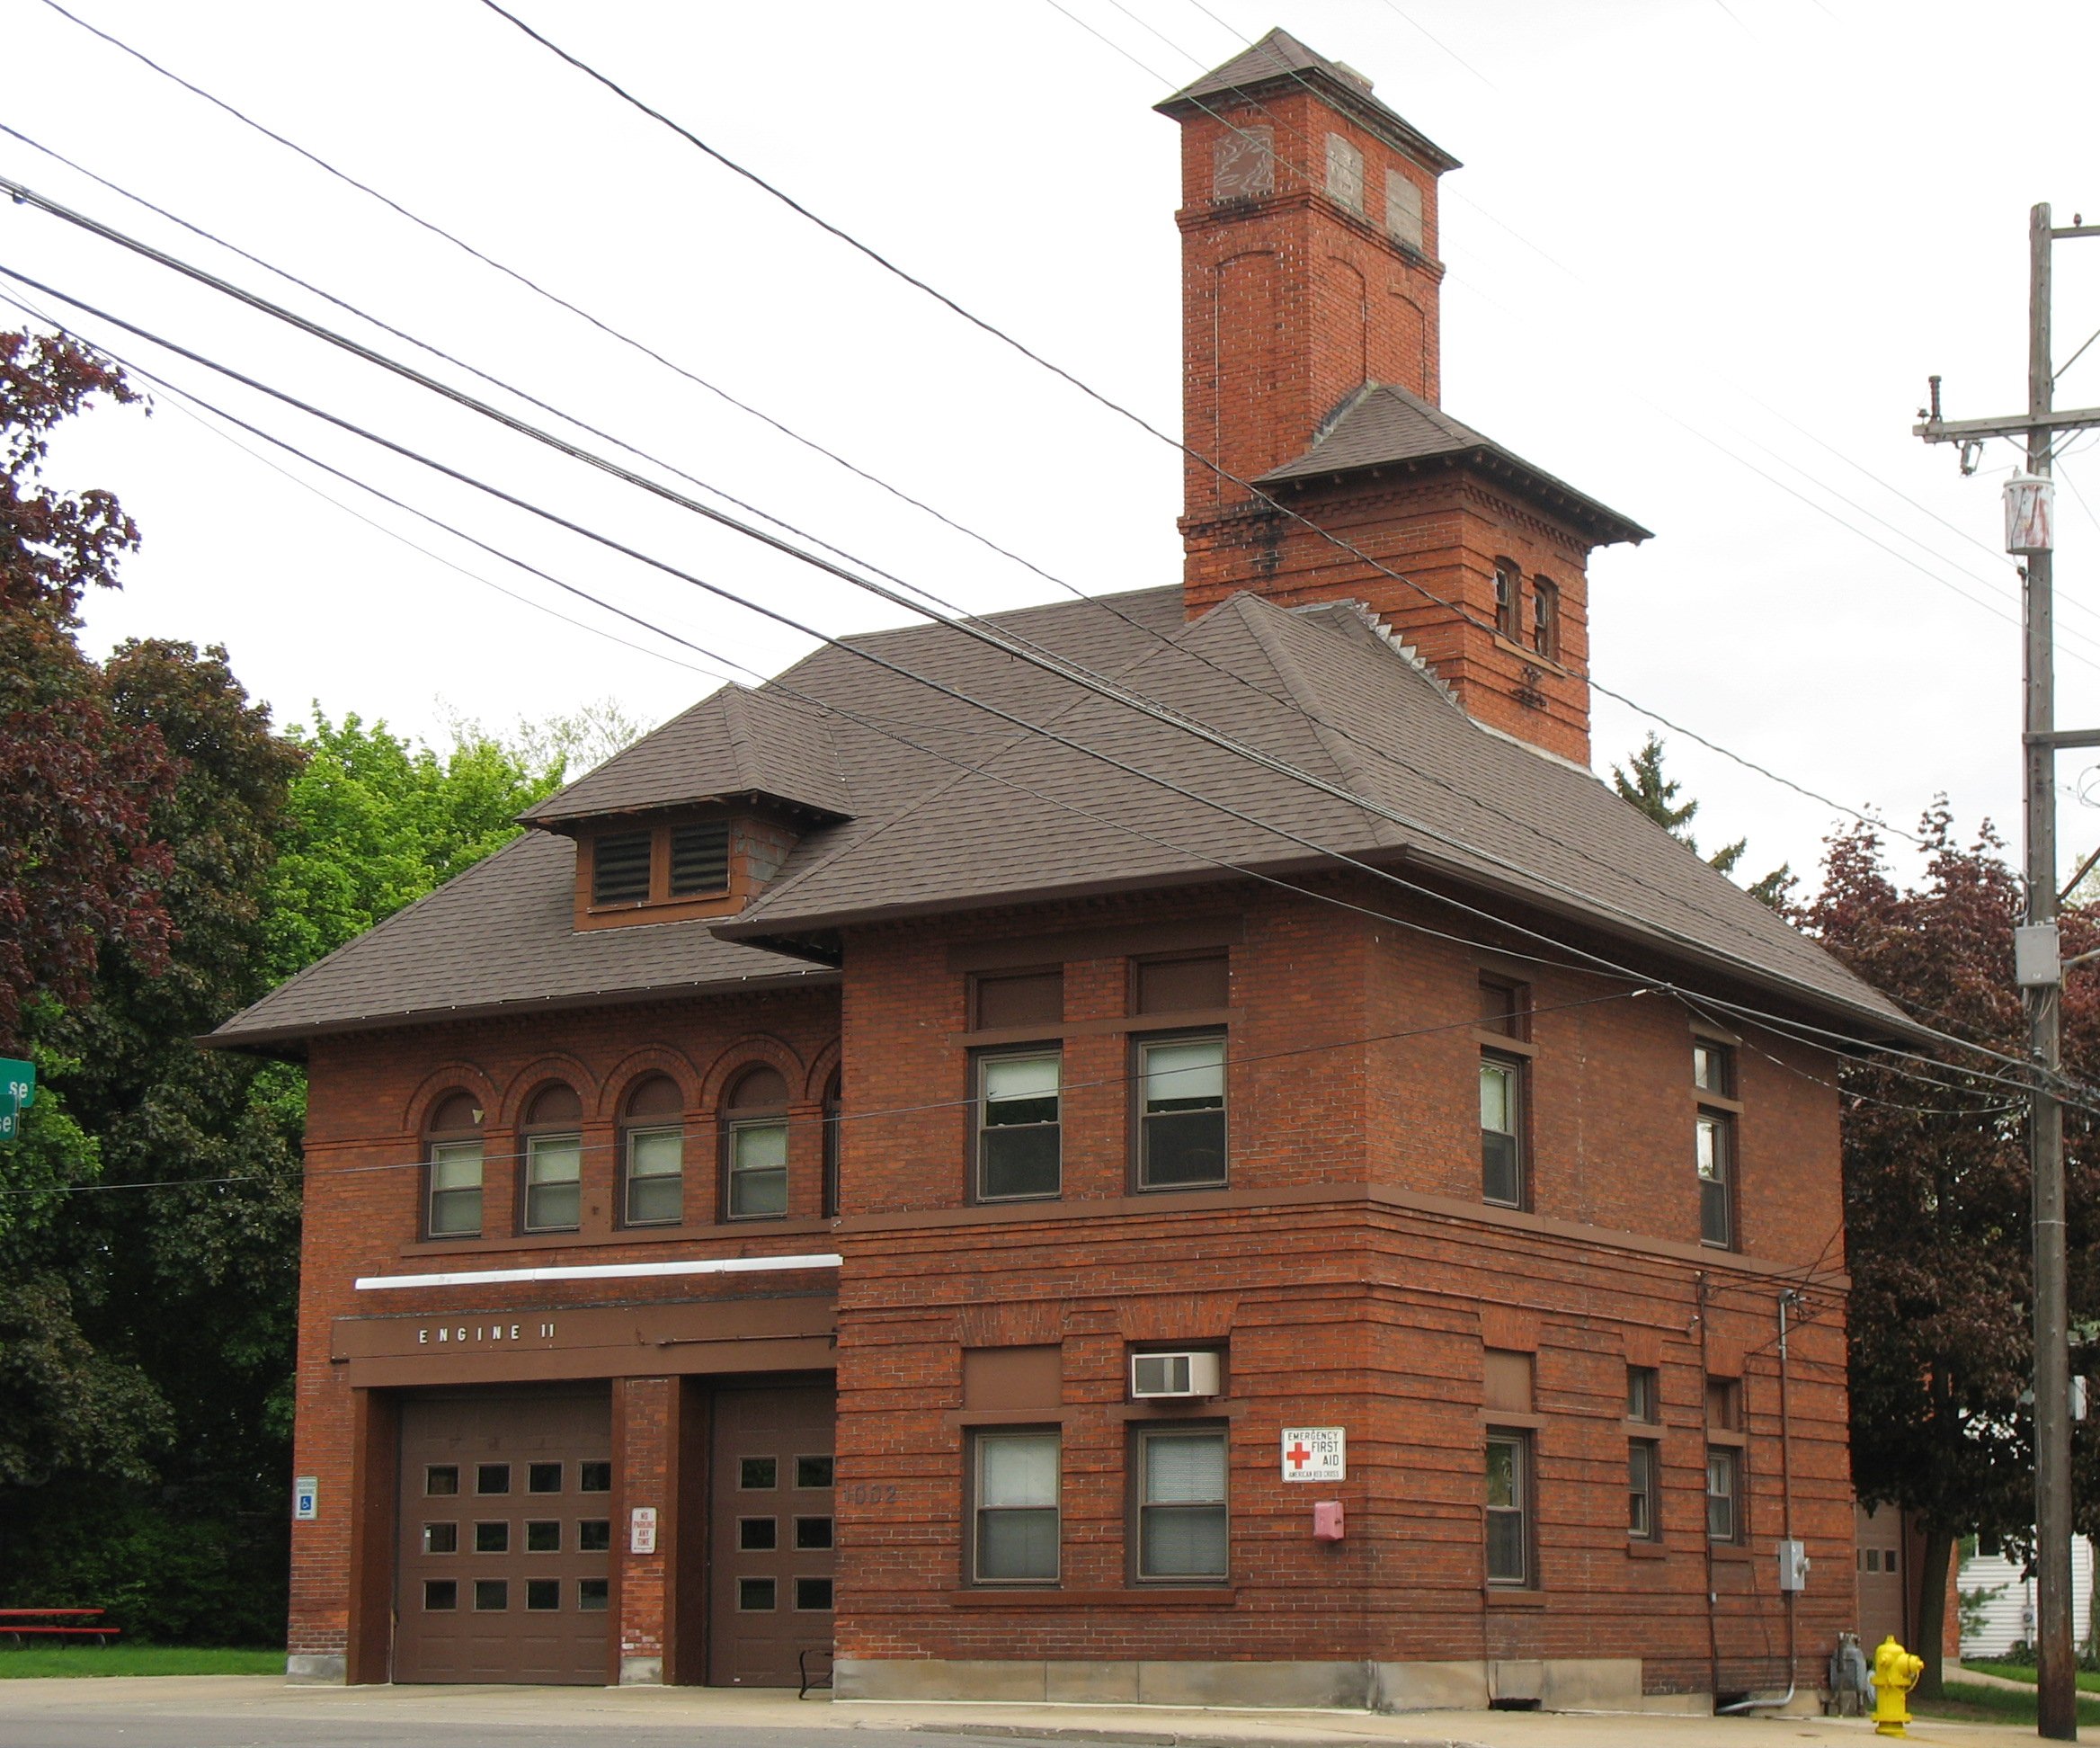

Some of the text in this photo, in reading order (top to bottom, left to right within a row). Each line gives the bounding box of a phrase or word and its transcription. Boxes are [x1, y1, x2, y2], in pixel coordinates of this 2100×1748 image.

[9, 1081, 28, 1098] se
[0, 1116, 12, 1132] e
[419, 1324, 555, 1343] ENGINE 11
[1287, 1431, 1339, 1440] EMERGENCY
[1312, 1441, 1339, 1452] FIRST
[1322, 1454, 1339, 1466] AID
[633, 1521, 655, 1529] PARKING
